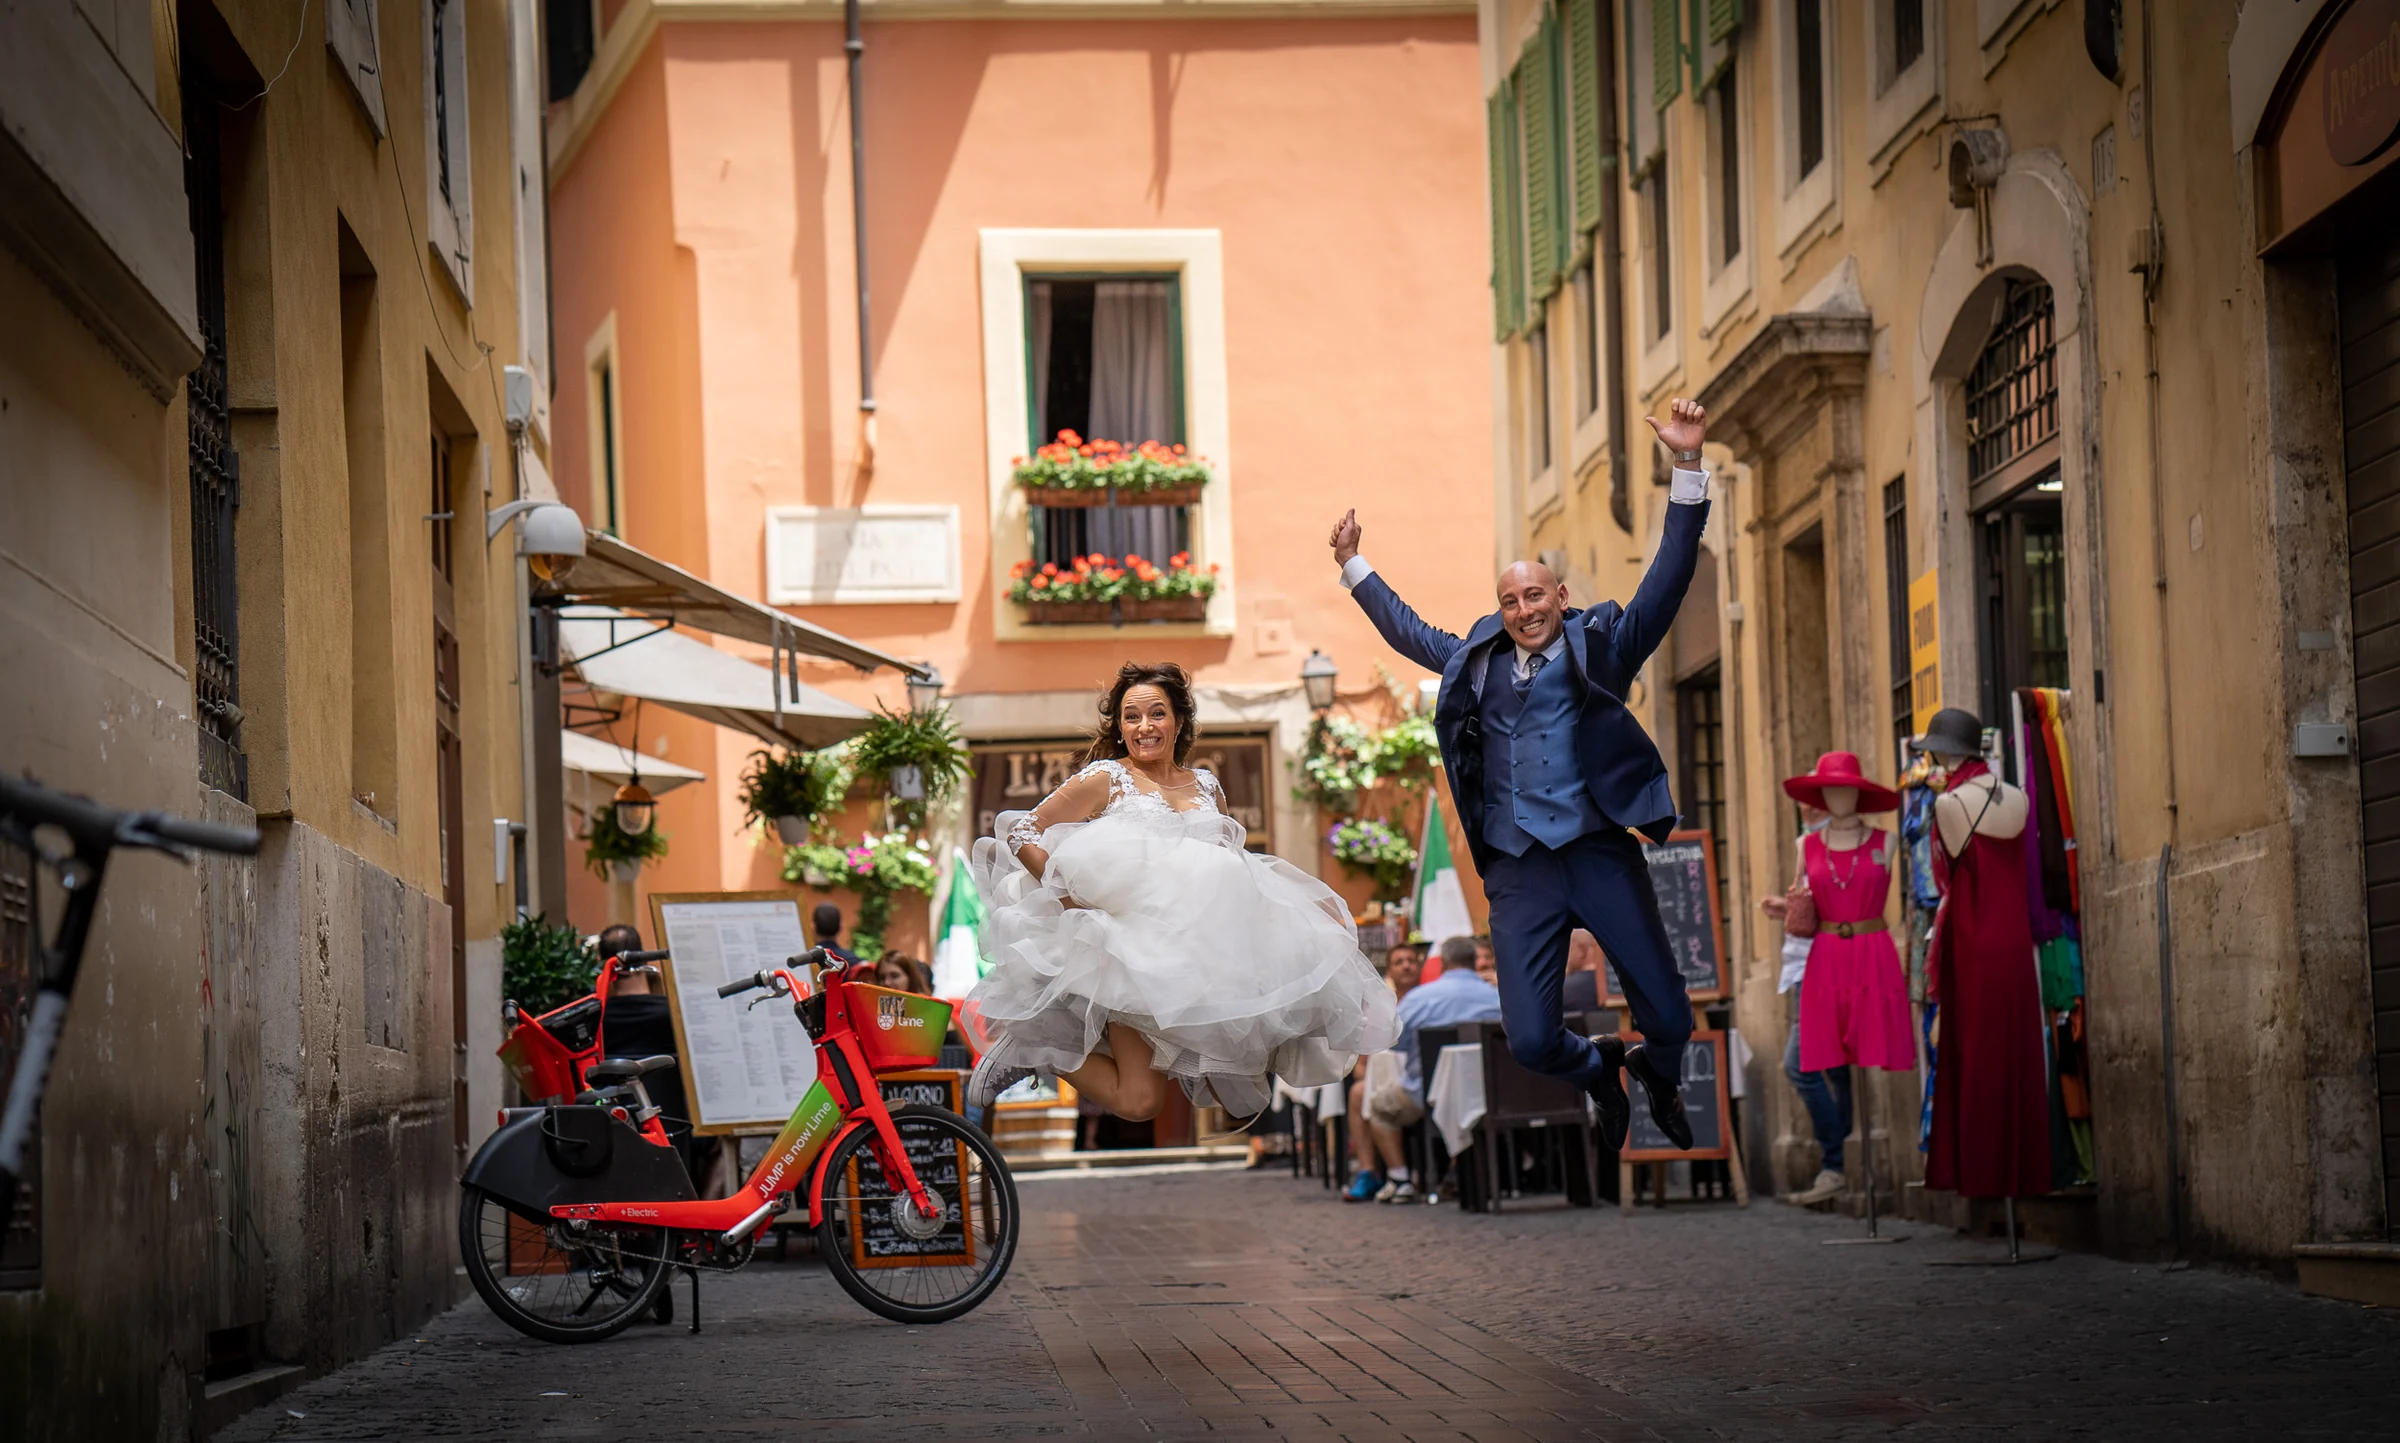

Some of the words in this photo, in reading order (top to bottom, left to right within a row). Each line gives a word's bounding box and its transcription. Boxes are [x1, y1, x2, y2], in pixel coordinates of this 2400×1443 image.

[2330, 20, 2400, 134] APPETITO
[758, 1163, 785, 1199] JUMP
[781, 1152, 795, 1166] is
[791, 1129, 812, 1157] now
[806, 1101, 833, 1131] Lime
[627, 1207, 659, 1218] Electric
